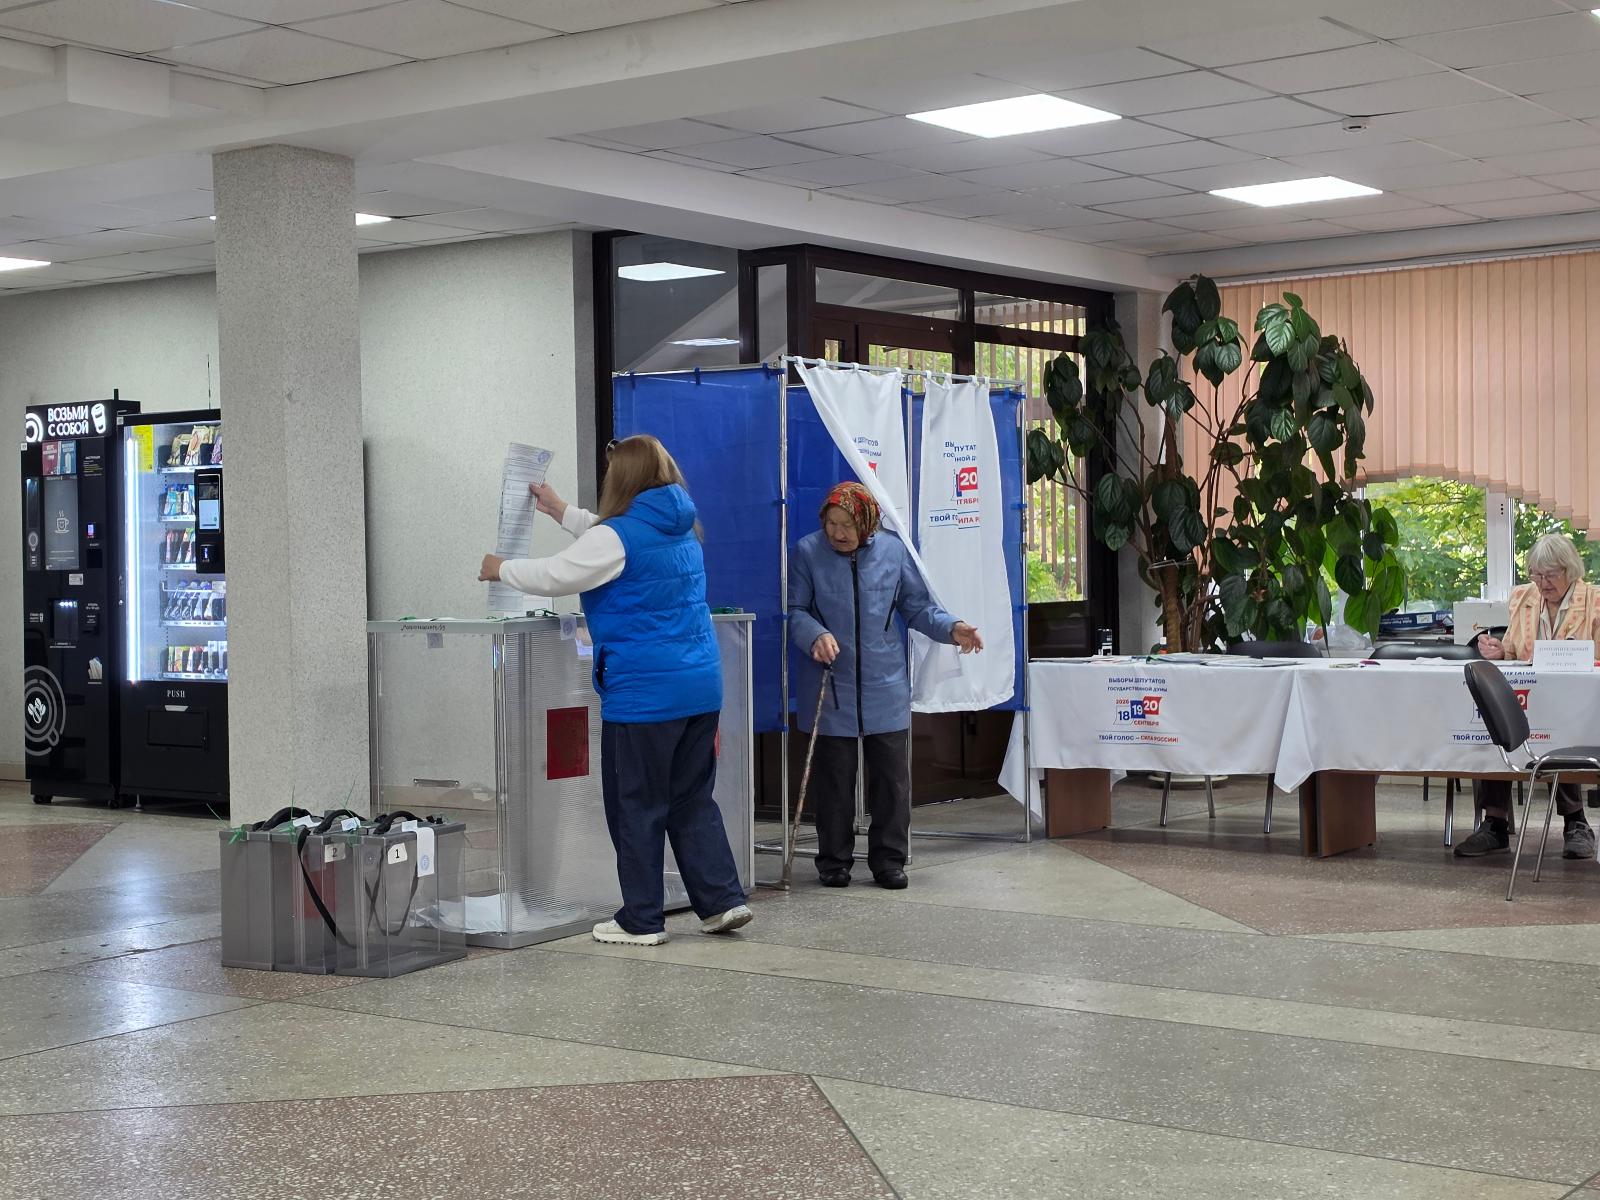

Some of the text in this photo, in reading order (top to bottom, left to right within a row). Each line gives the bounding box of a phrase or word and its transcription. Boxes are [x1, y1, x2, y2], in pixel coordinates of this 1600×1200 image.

[47, 404, 89, 422] ВОЗЬМИ
[47, 420, 89, 437] С СОБОЙ
[959, 471, 978, 486] 20
[930, 513, 951, 522] ТВОЙ
[167, 690, 185, 698] PUSH
[1132, 704, 1143, 715] 19
[1143, 700, 1159, 711] 20
[1118, 710, 1130, 721] 18
[1098, 733, 1113, 741] ТВОЙ
[332, 847, 338, 857] 2
[395, 848, 400, 859] 1
